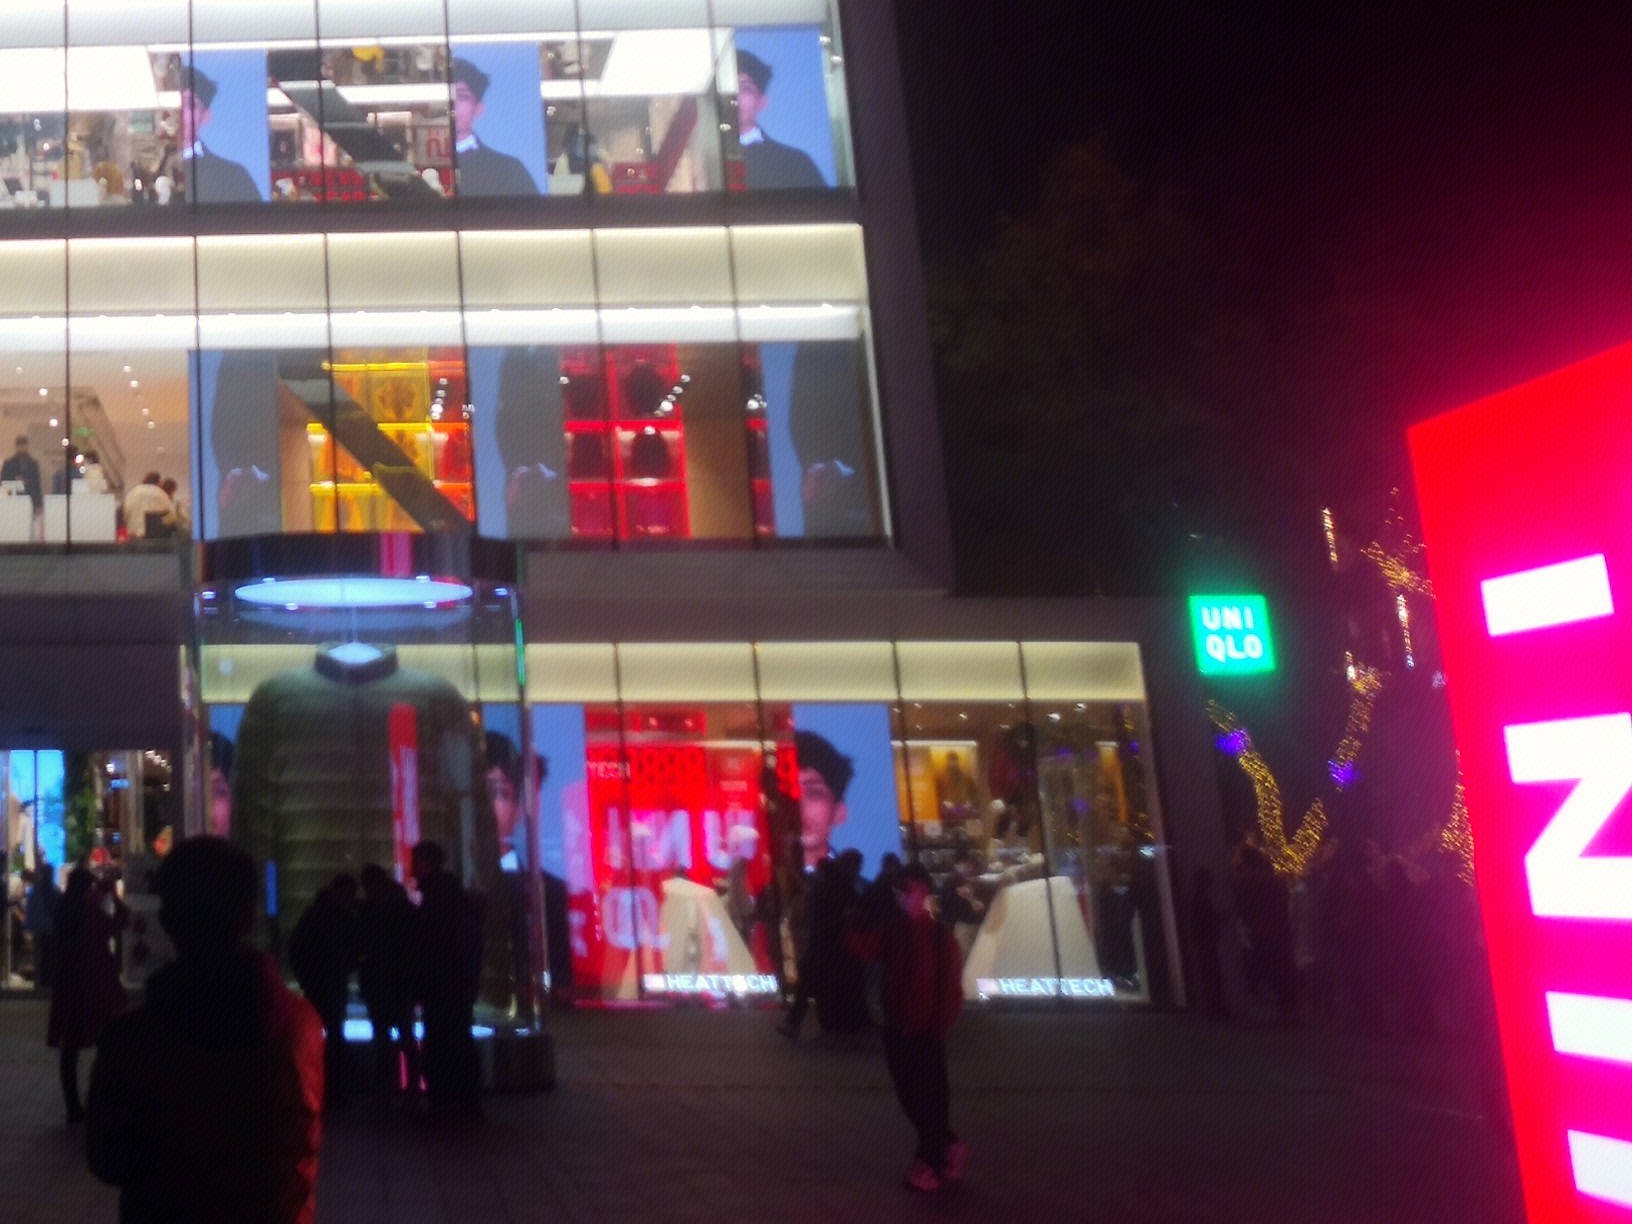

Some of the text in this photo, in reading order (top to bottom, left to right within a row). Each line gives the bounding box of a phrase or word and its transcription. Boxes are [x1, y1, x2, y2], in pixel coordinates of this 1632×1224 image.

[1200, 605, 1255, 631] UNI
[1205, 633, 1264, 664] QLO
[665, 974, 779, 993] HEATTCH
[998, 977, 1116, 996] HEATTECH
